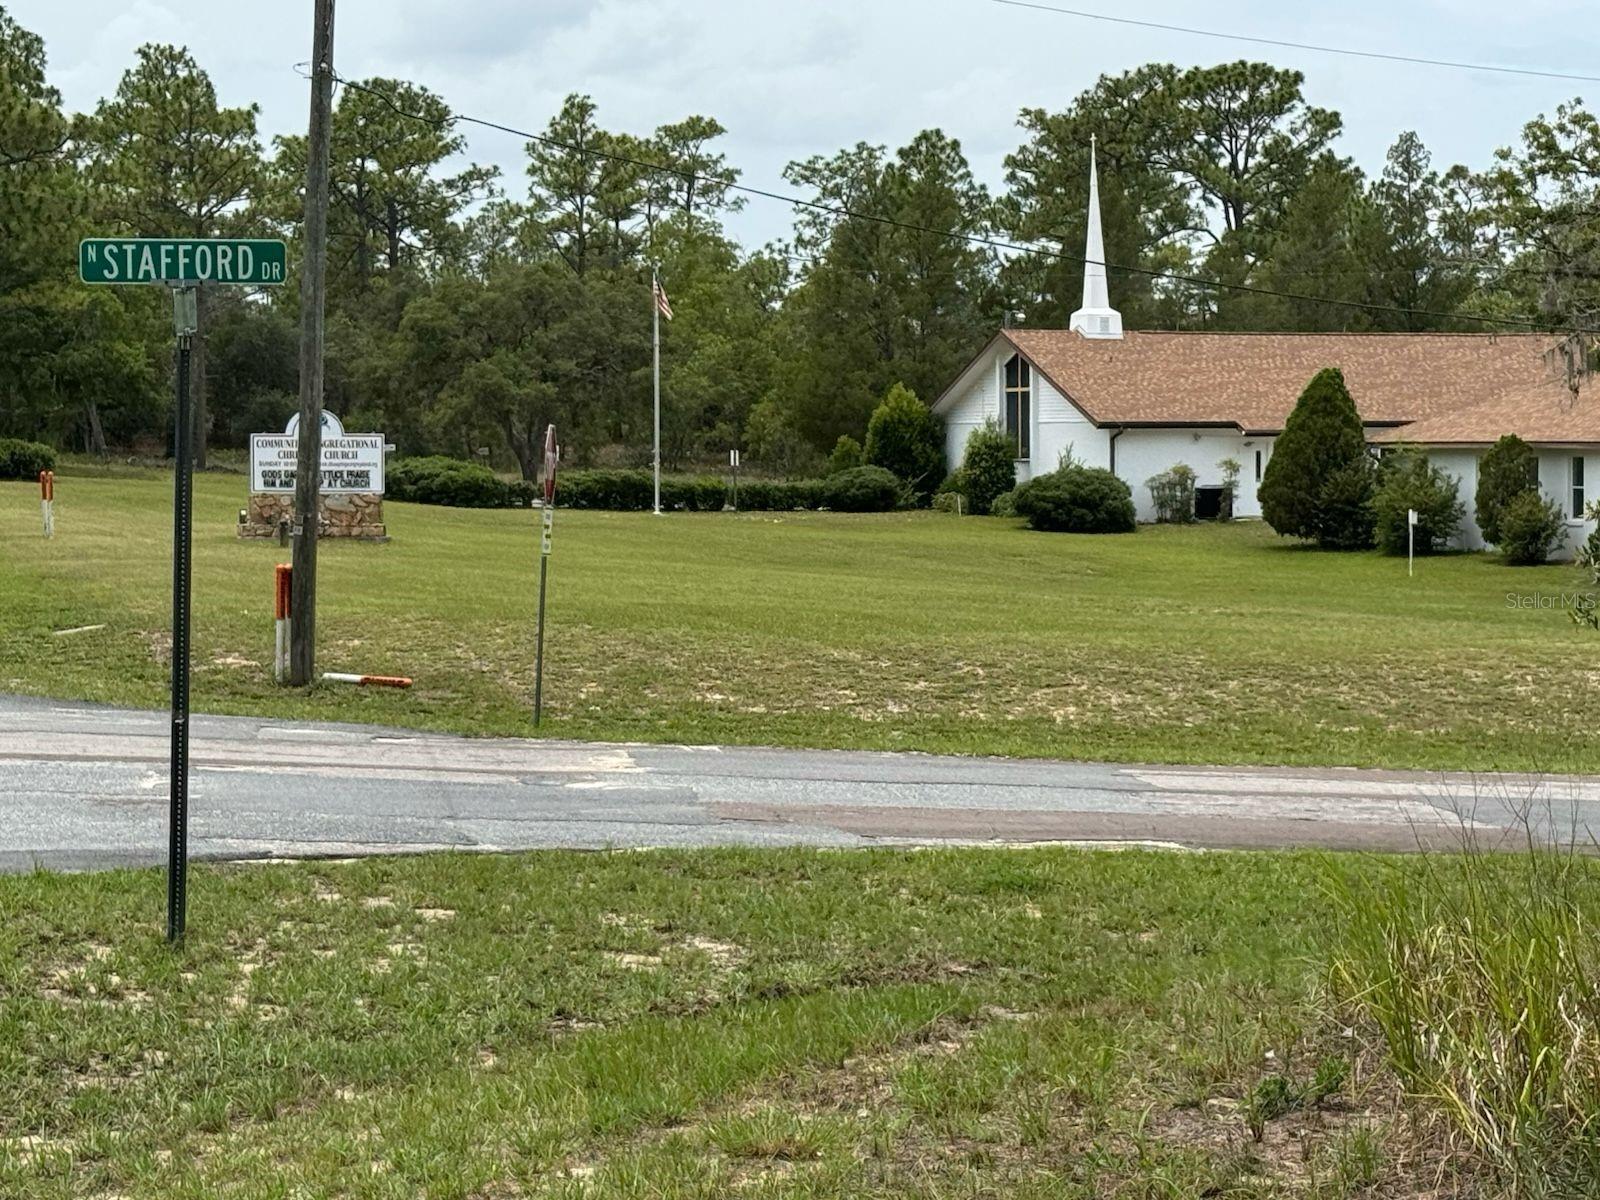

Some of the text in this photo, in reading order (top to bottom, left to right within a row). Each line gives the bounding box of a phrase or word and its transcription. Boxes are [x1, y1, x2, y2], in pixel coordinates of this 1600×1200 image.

[87, 244, 281, 280] N STAFFORD DR
[324, 450, 358, 460] CHURCH
[279, 479, 294, 488] AND
[328, 479, 338, 488] AT
[340, 479, 370, 488] CHURCH
